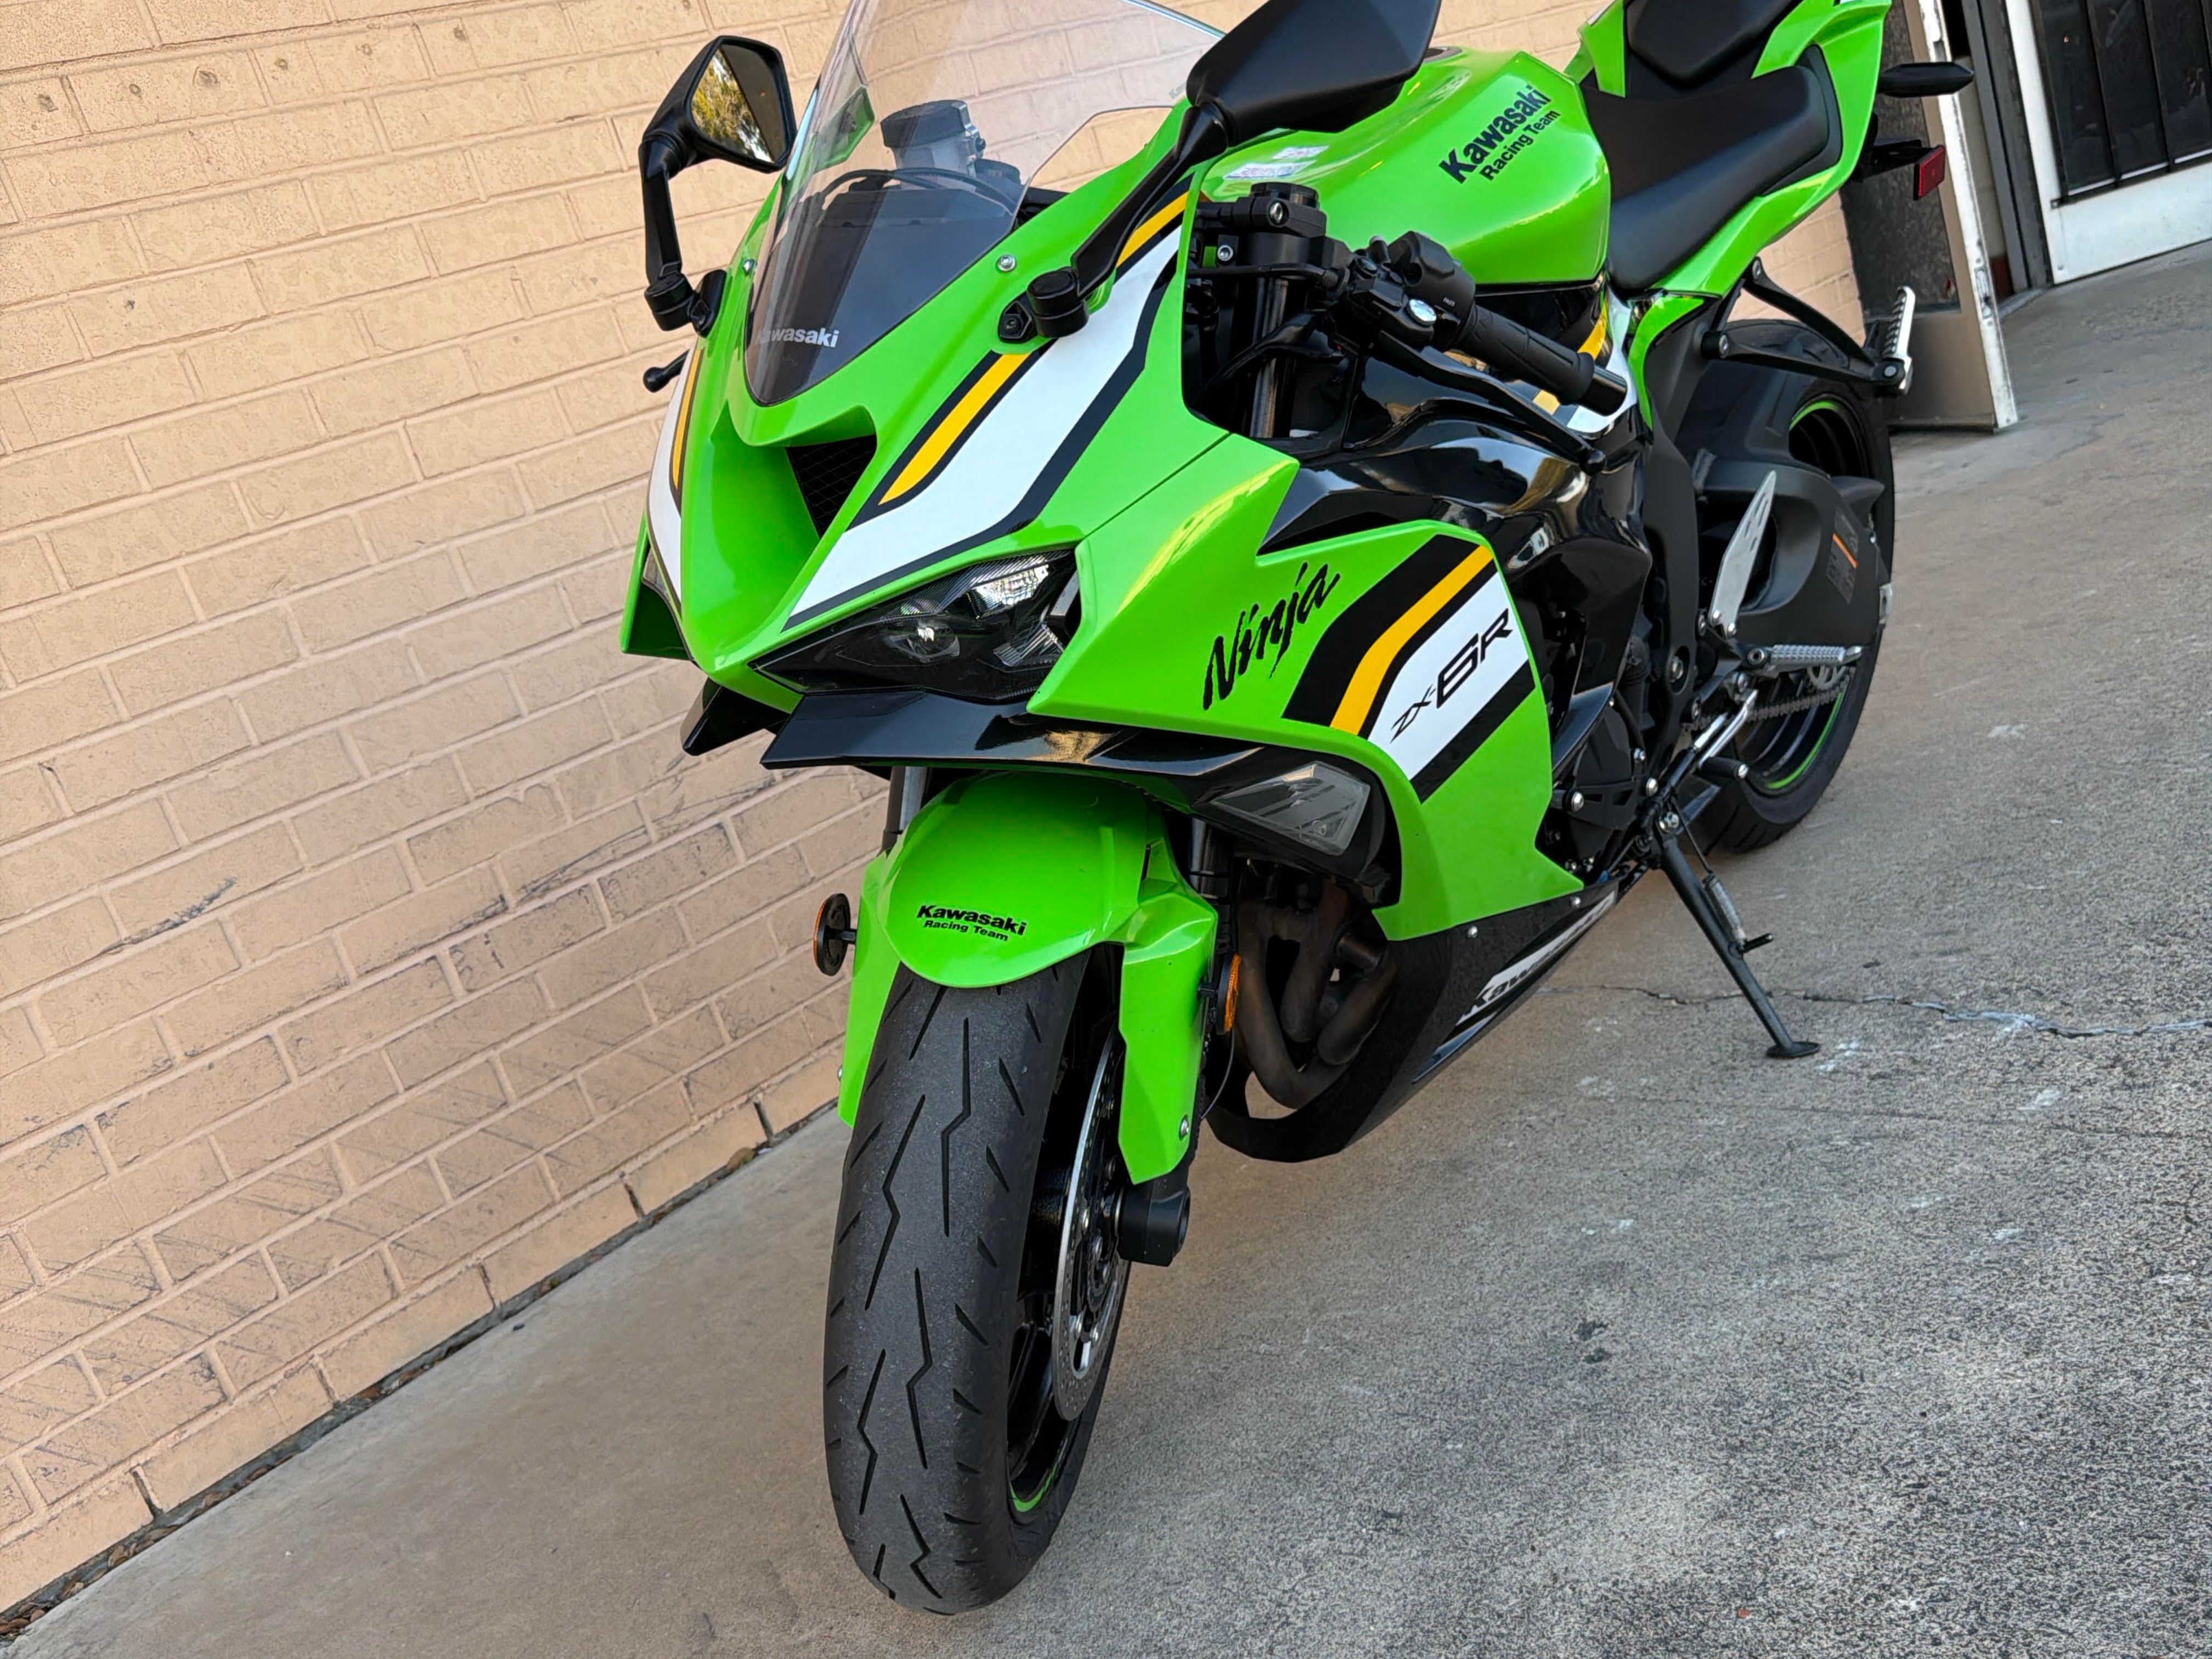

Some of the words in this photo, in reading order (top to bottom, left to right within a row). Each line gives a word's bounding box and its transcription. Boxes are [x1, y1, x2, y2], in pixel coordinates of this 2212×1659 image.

[1438, 84, 1551, 184] Kawasaki
[1480, 133, 1534, 181] Racing
[1522, 110, 1561, 139] Team
[758, 328, 840, 348] awasaki
[1203, 562, 1341, 710] Ninja
[917, 905, 1028, 936] Kawasaki
[924, 920, 969, 933] Racing
[973, 925, 1008, 941] Team
